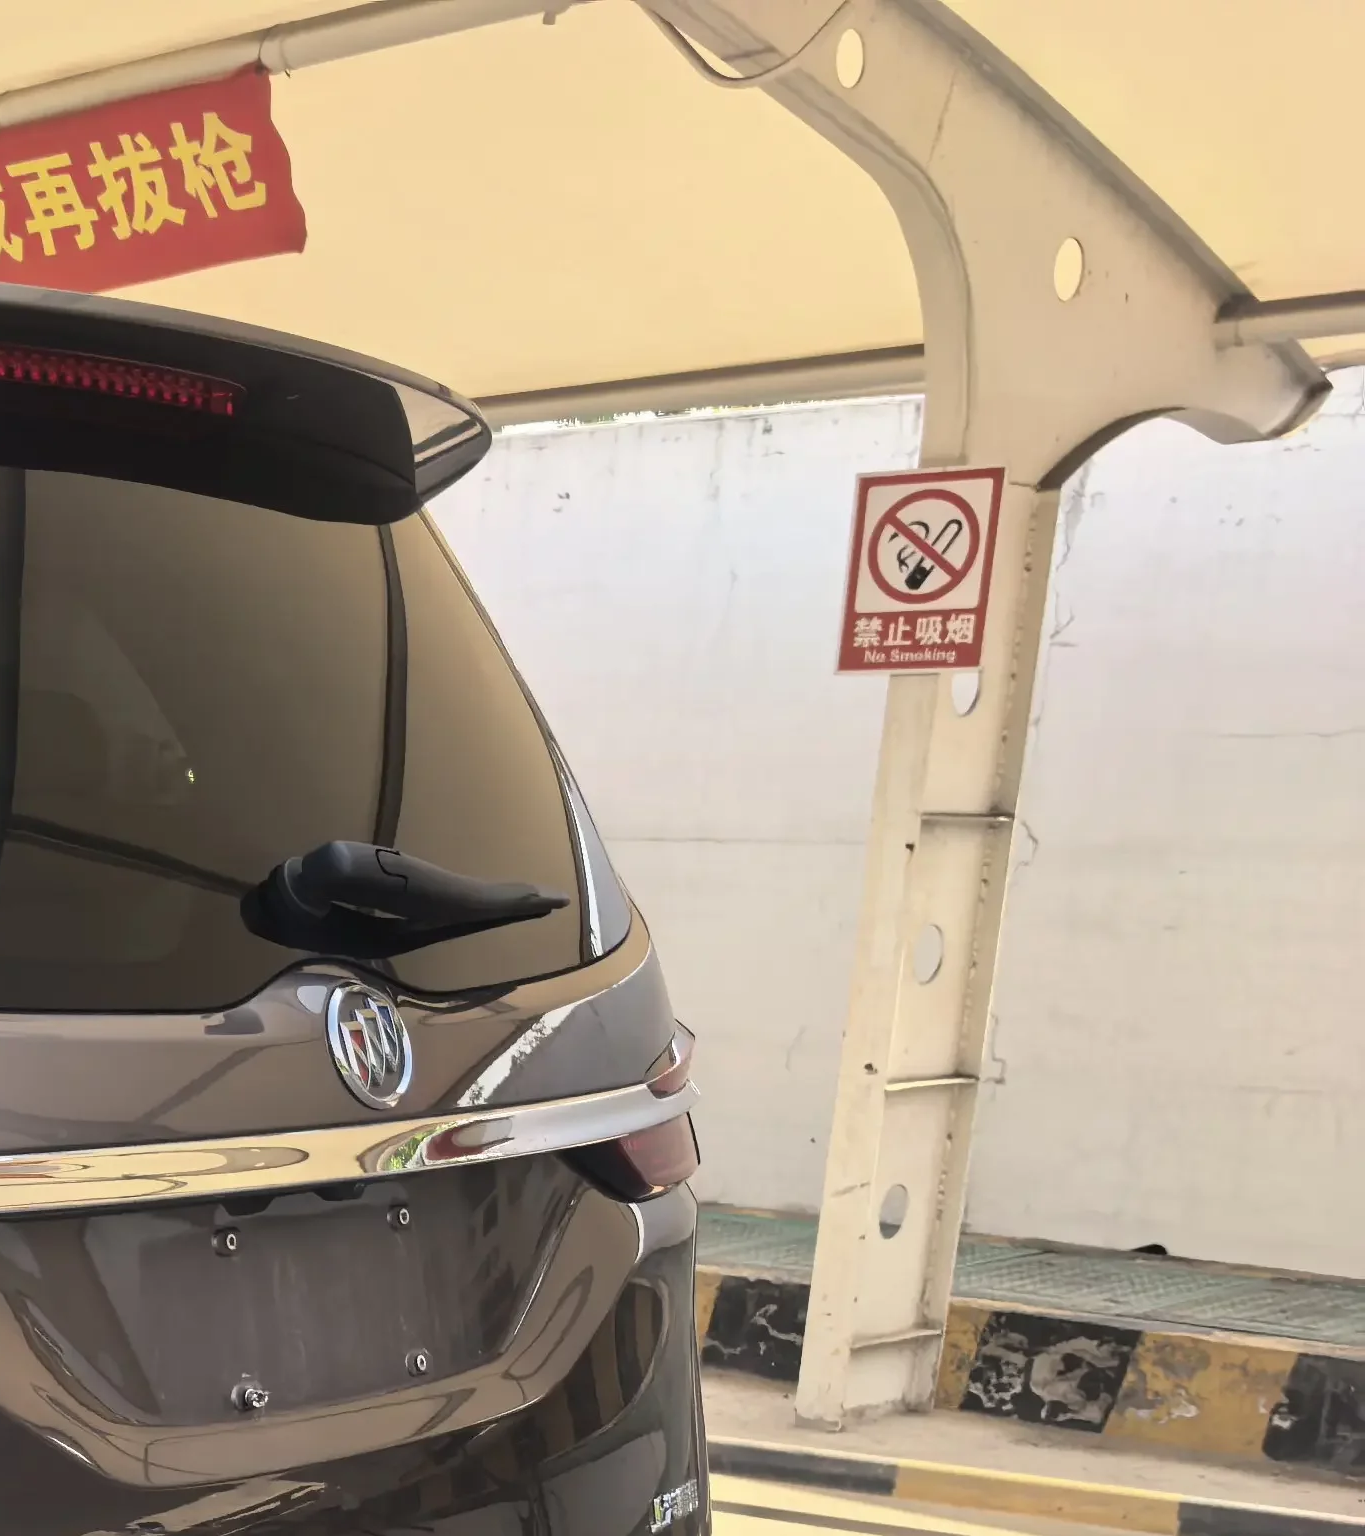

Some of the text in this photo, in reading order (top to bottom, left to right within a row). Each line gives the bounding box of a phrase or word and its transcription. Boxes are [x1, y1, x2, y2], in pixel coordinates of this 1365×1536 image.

[853, 613, 976, 647] 禁止吸烟
[864, 647, 956, 663] No Smoking
